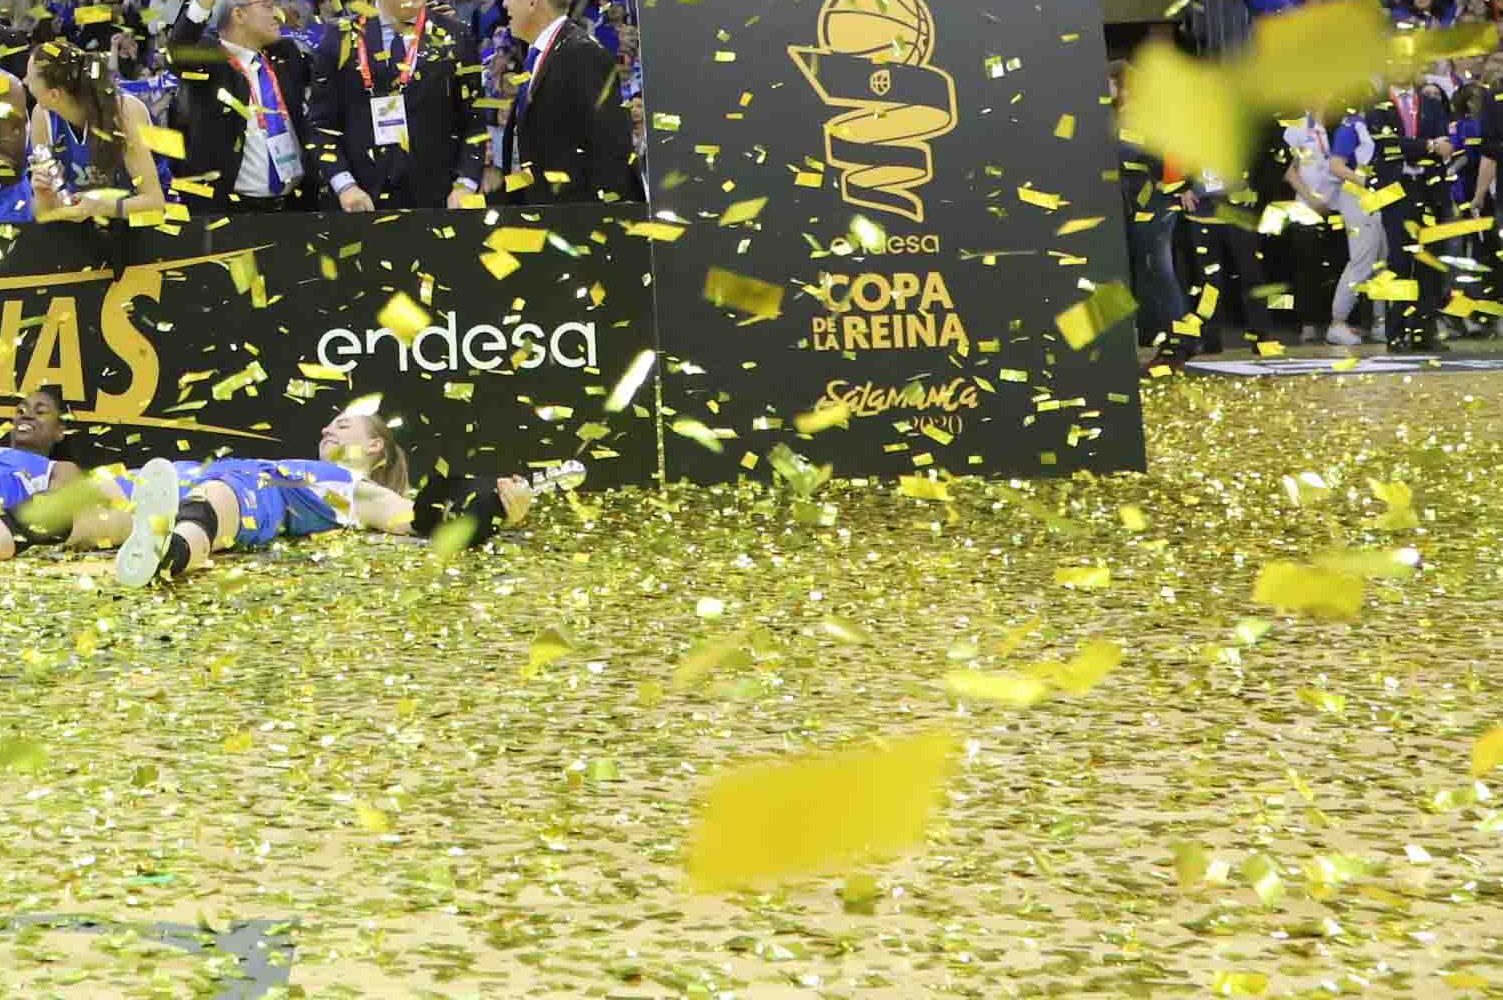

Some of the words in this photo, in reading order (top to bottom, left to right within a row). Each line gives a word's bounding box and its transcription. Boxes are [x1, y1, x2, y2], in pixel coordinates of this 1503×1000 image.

[822, 272, 954, 313] COPA
[317, 310, 598, 372] endesa
[812, 317, 836, 333] DE
[814, 334, 839, 350] LA
[843, 313, 969, 349] REINA
